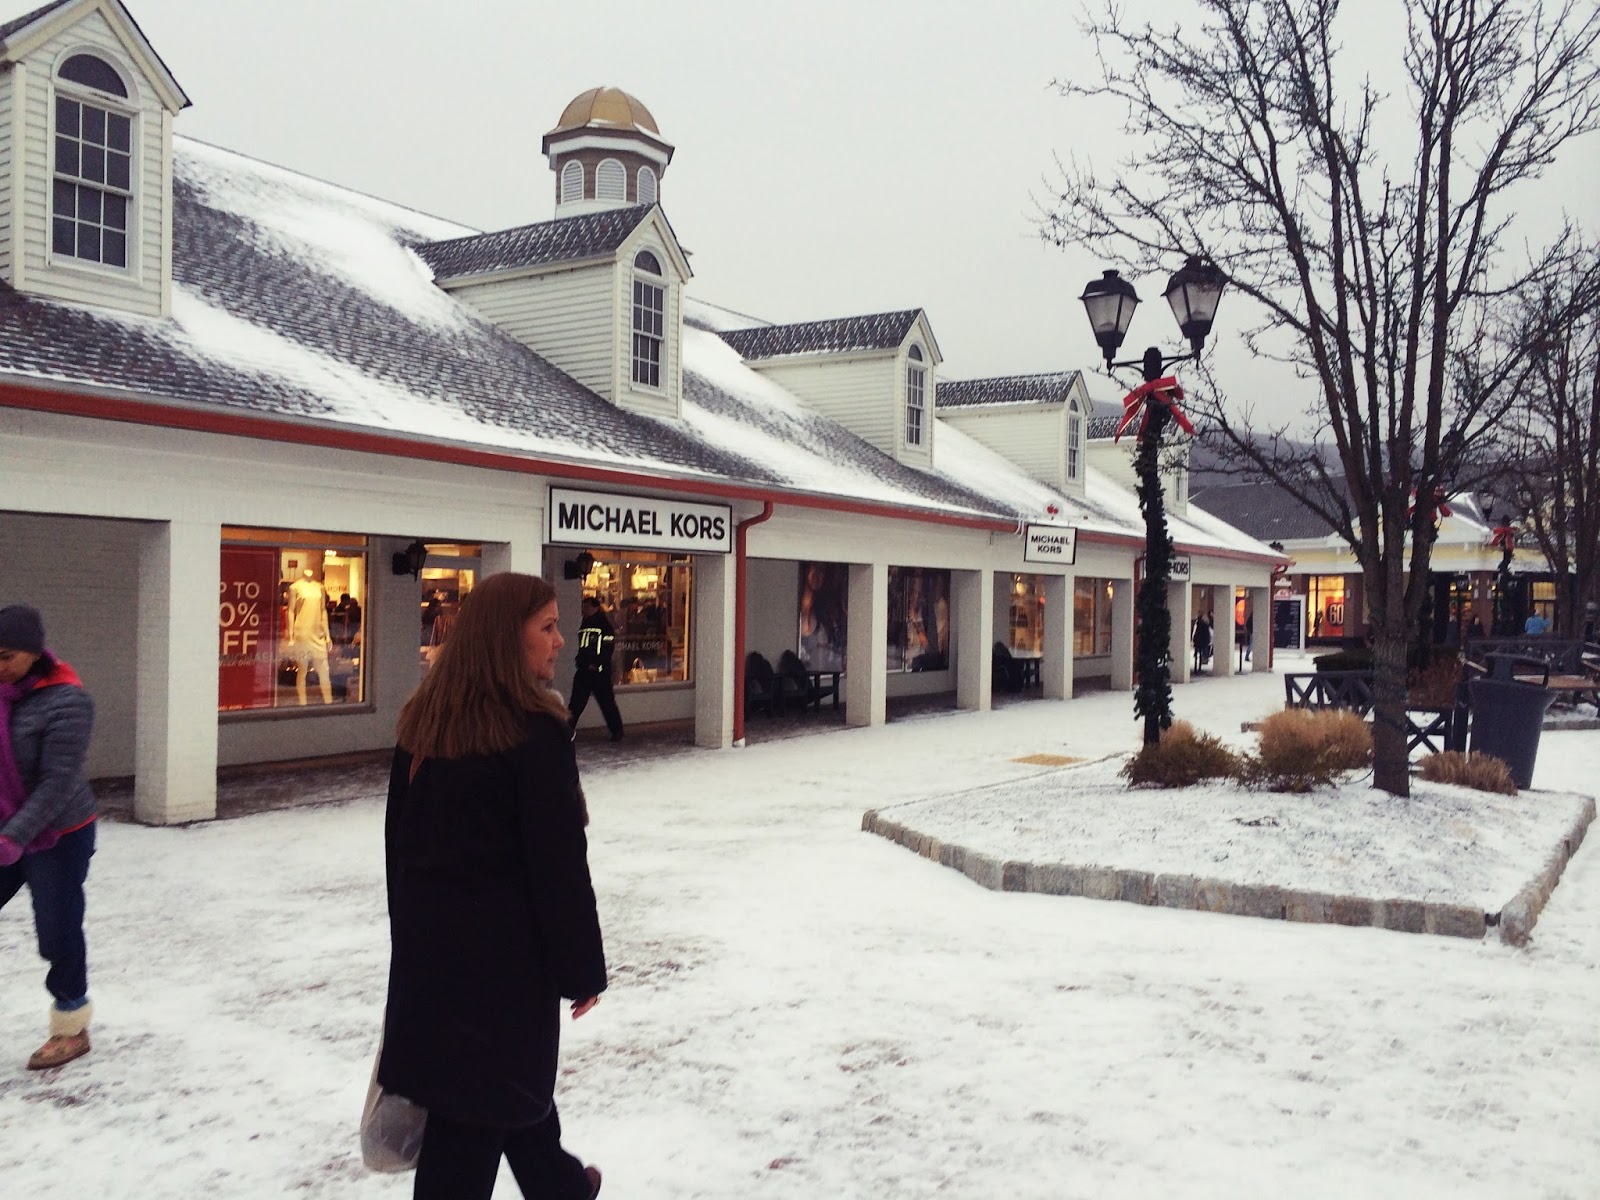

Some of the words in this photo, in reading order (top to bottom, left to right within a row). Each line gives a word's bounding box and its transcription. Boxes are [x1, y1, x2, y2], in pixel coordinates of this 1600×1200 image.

[558, 502, 663, 536] MICHAEL
[670, 512, 725, 540] KORS
[1031, 535, 1070, 545] MICHAEL
[1037, 545, 1062, 554] KORS
[233, 581, 260, 599] TO
[219, 602, 260, 628] 0%
[1330, 603, 1344, 625] 60
[223, 630, 259, 655] FF
